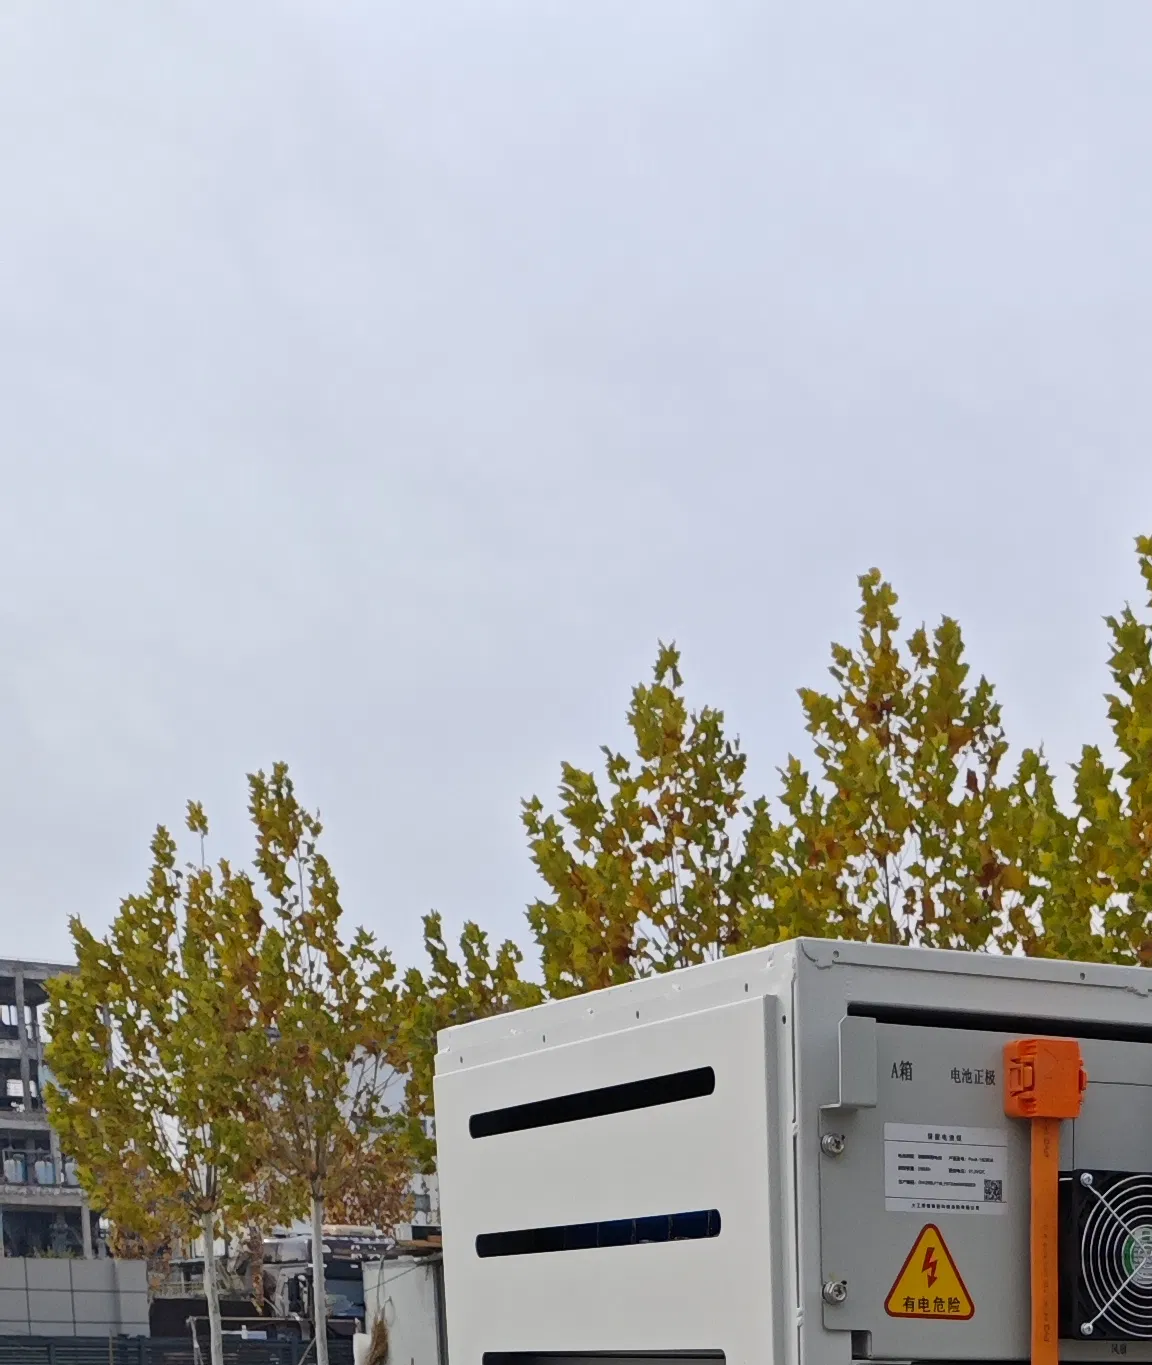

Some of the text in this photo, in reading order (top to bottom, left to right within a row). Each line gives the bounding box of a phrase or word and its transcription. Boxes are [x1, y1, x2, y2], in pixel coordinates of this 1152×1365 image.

[891, 1061, 912, 1081] A箱
[951, 1067, 995, 1086] 电池正极
[903, 1296, 961, 1313] 有电危险
